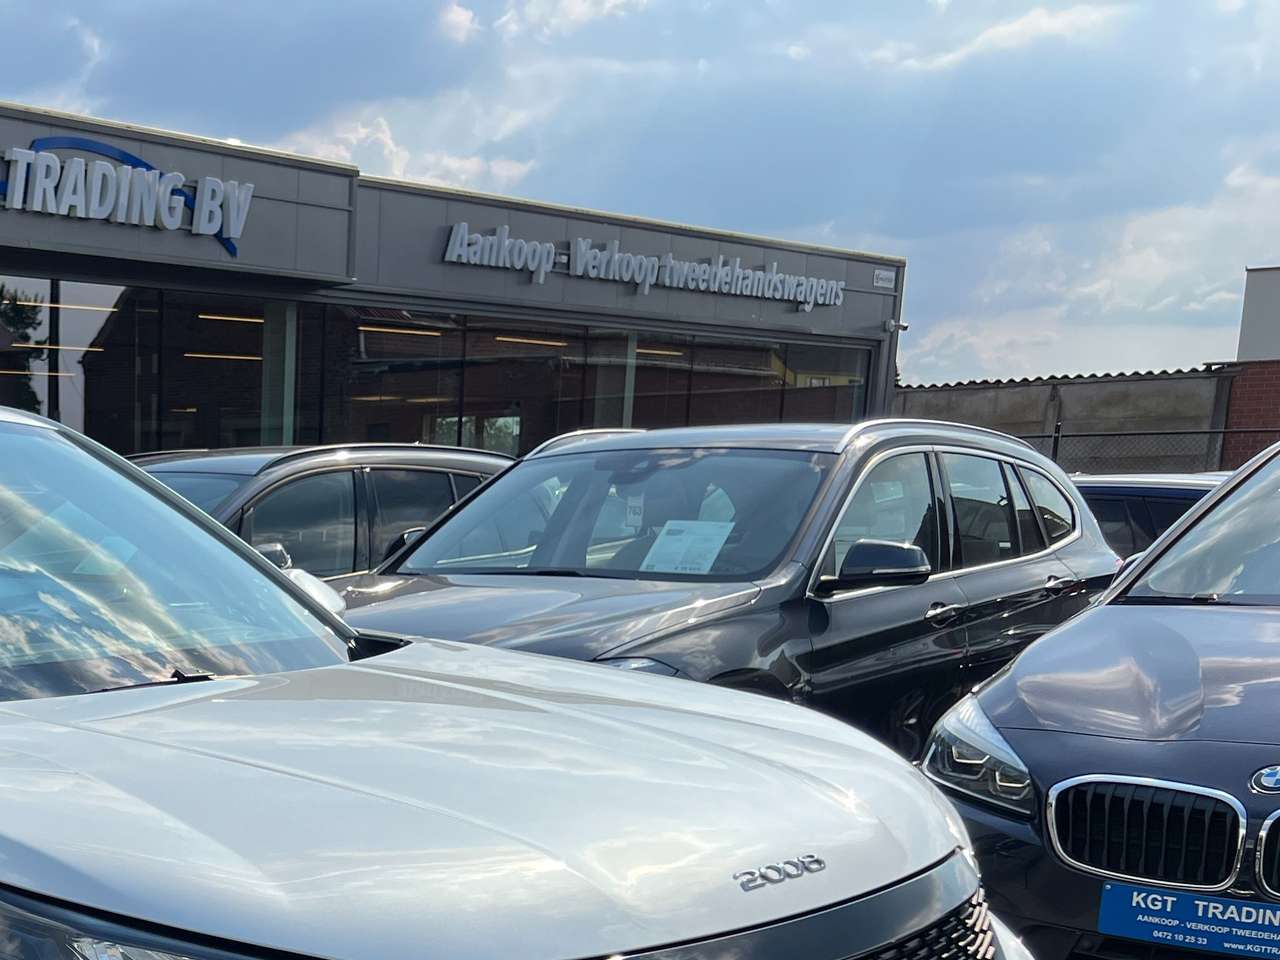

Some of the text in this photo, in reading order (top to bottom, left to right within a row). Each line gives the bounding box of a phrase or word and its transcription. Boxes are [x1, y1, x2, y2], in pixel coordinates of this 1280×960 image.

[6, 147, 186, 231] TRADING
[192, 176, 254, 239] BV
[445, 222, 555, 284] Aankoop
[571, 237, 659, 295] Verkoop
[658, 253, 846, 312] tweedehandswagens
[732, 853, 826, 893] 2008
[1131, 891, 1176, 912] KGT
[1136, 914, 1179, 927] AANKOOP
[1186, 921, 1230, 934] VERKOOP
[1152, 930, 1172, 940] 0472
[1174, 934, 1183, 942] 10
[1185, 936, 1195, 944] 25
[1196, 937, 1208, 945] 33
